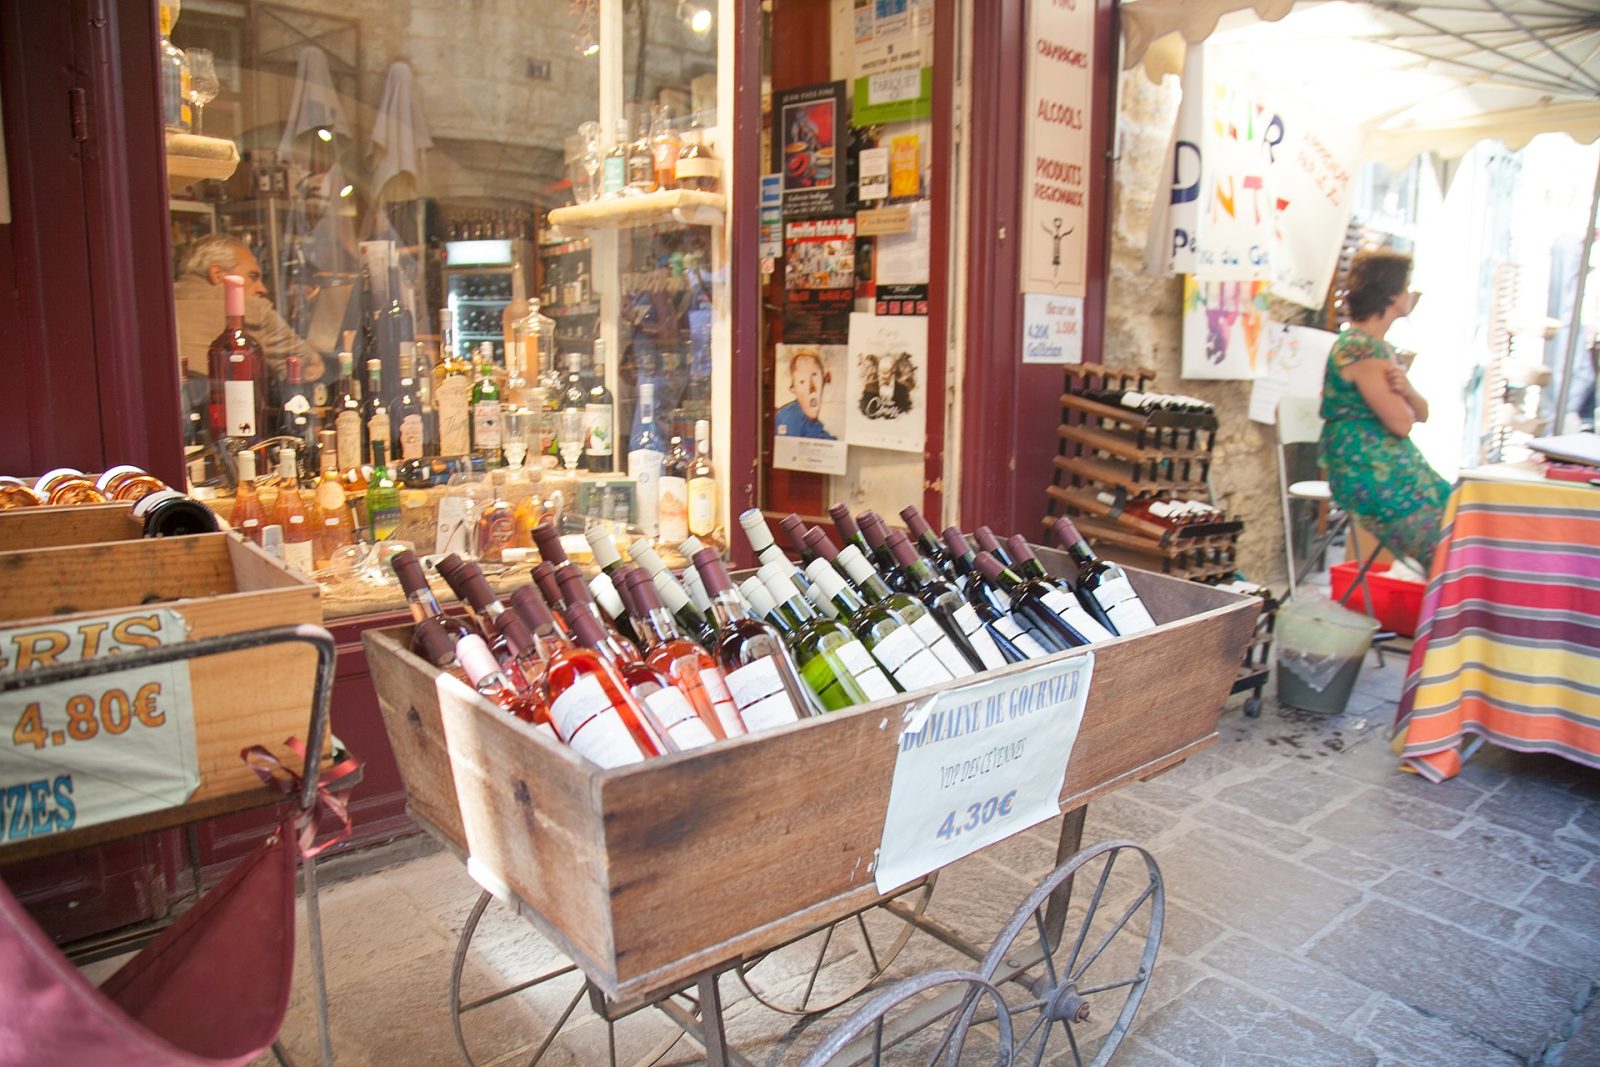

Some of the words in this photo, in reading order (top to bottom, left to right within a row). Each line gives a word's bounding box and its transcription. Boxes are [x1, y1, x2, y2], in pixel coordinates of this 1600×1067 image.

[1037, 98, 1082, 131] ALCOOLS
[1036, 156, 1081, 186] PRODUITS
[0, 614, 162, 674] RIS
[13, 681, 167, 751] 4.80€
[902, 699, 981, 753] DOMAINE
[985, 691, 1006, 729] DE
[1009, 670, 1080, 719] GOURNIER
[0, 775, 76, 842] ZES
[935, 790, 1018, 842] 4.30€
